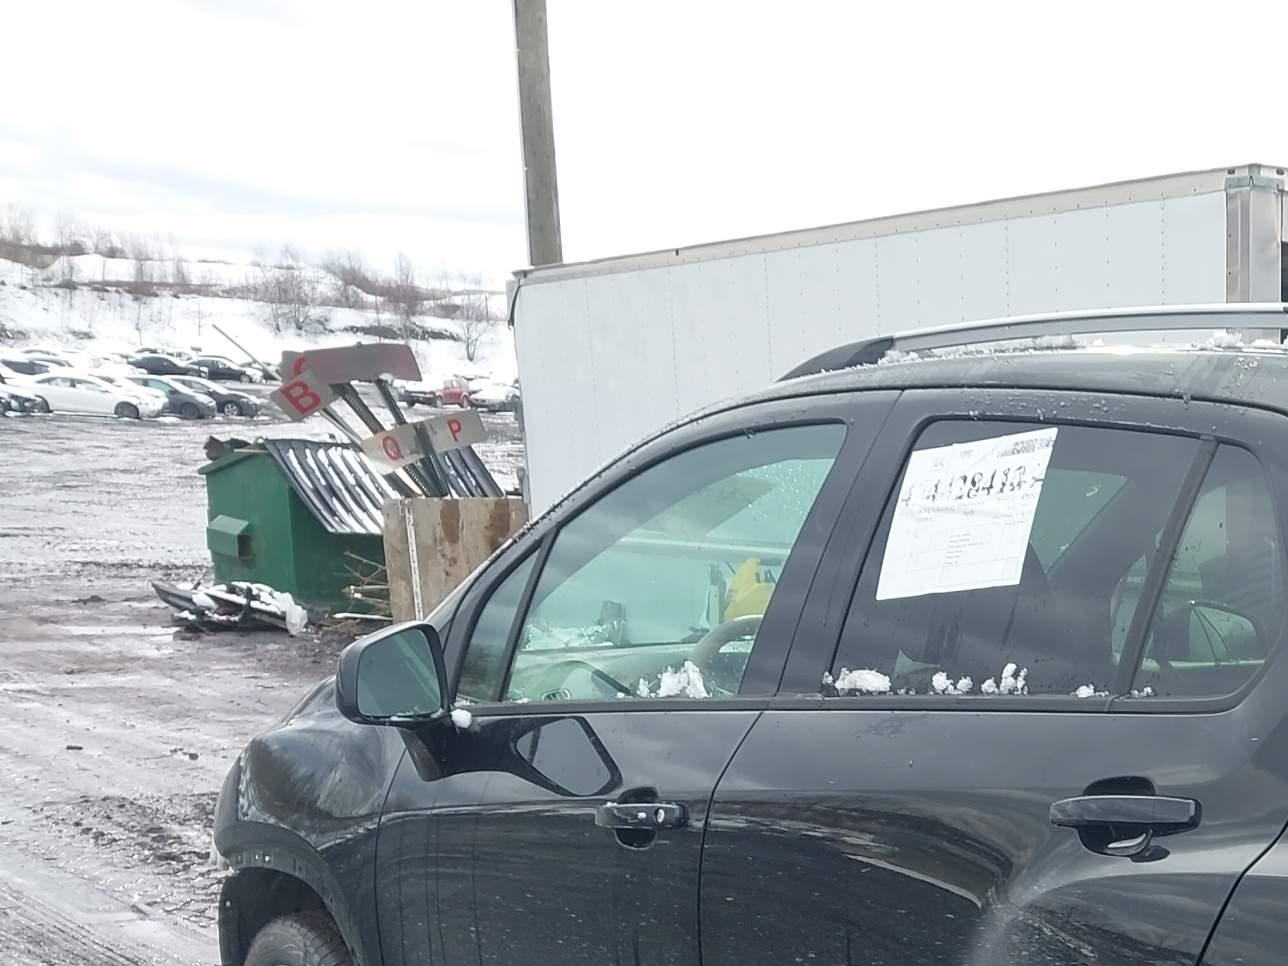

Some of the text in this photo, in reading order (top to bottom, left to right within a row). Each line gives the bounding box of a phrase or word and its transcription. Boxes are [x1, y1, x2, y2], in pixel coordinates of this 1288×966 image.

[280, 380, 321, 416] B
[447, 418, 462, 442] P
[381, 434, 404, 460] Q
